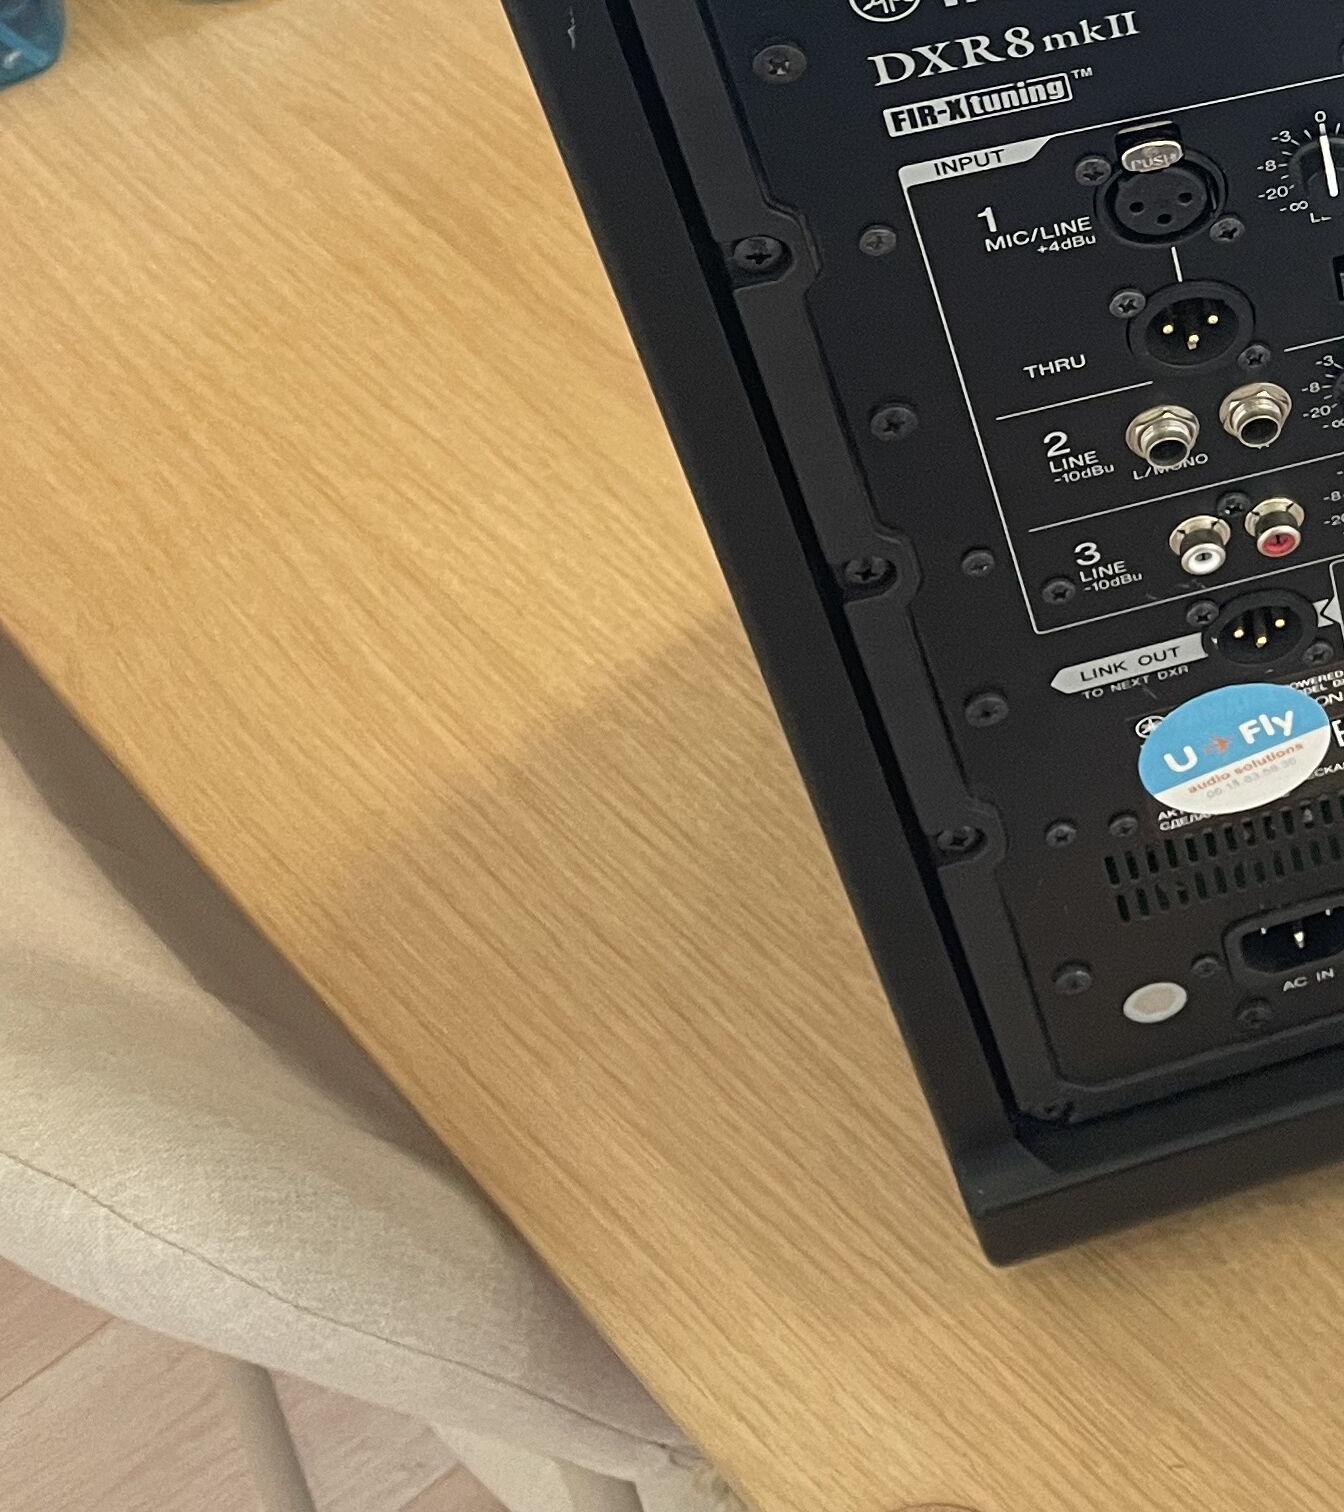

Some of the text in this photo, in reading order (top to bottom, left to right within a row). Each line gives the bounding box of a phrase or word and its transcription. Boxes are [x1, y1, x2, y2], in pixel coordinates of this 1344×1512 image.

[1314, 110, 1327, 123] 0
[934, 148, 1005, 177] INPUT
[977, 206, 999, 234] 1
[984, 215, 1094, 253] MIC/LINE
[1037, 234, 1097, 254] +4dBu
[1022, 354, 1087, 379] THRU
[1043, 431, 1071, 458] 2
[1049, 450, 1100, 474] LINE
[1053, 463, 1115, 485] -10dBu
[1073, 541, 1101, 566] 3
[1079, 560, 1128, 583] LINE
[1080, 646, 1181, 683] LINK OUT
[1083, 665, 1189, 700] TO NEXT DXR
[1289, 670, 1344, 689] OWERED
[1163, 710, 1294, 773] U Fly
[1188, 743, 1304, 794] audio solutions
[1283, 968, 1334, 992] AC IN
